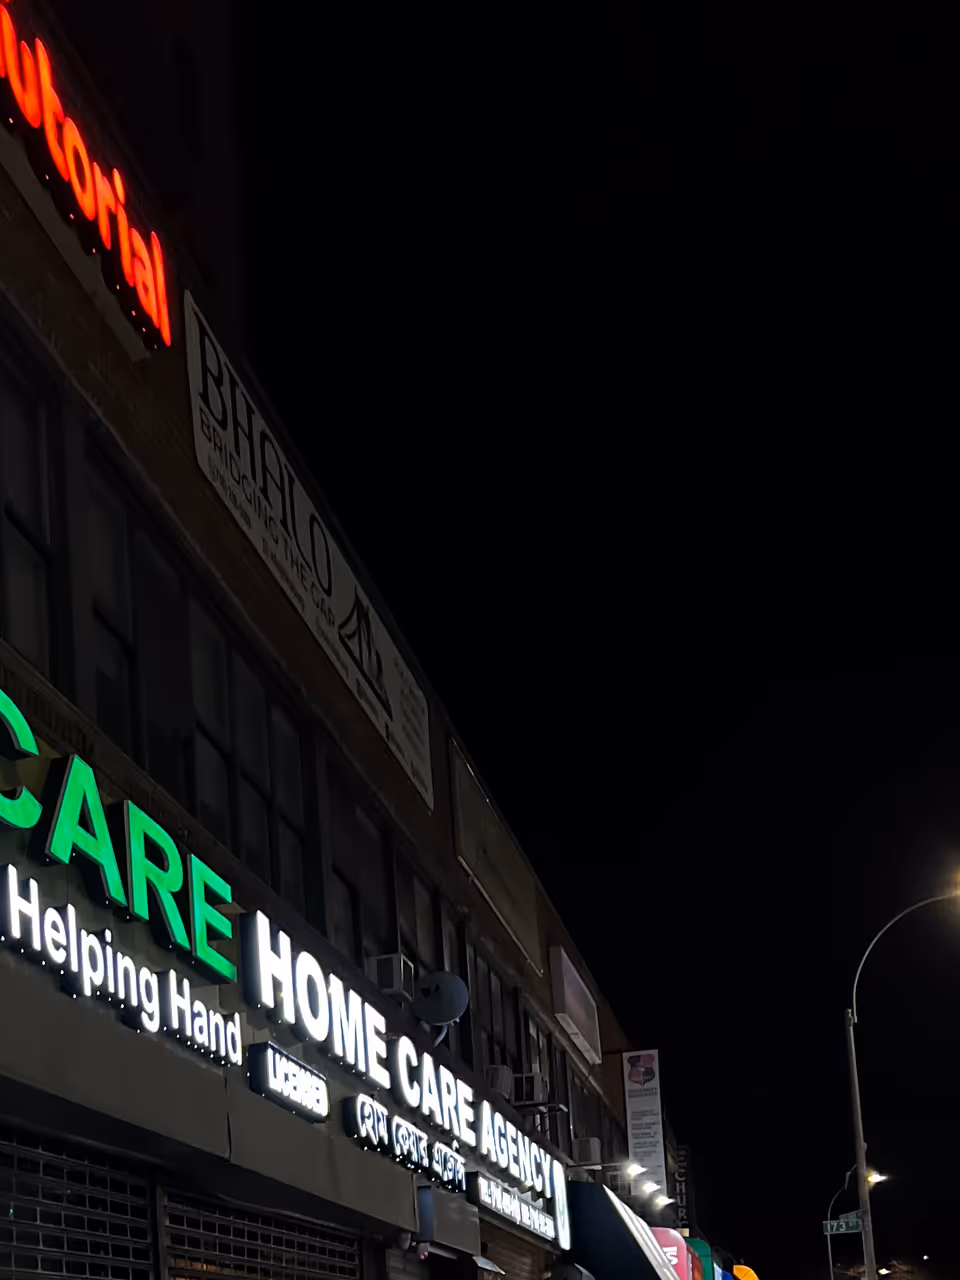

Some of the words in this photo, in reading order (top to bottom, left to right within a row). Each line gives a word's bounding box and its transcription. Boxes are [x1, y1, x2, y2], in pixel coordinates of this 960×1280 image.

[6, 863, 160, 1032] Helping
[168, 967, 244, 1066] Hand
[255, 909, 391, 1090] HOME
[396, 1035, 477, 1147] CARE
[480, 1099, 552, 1199] AGENCY
